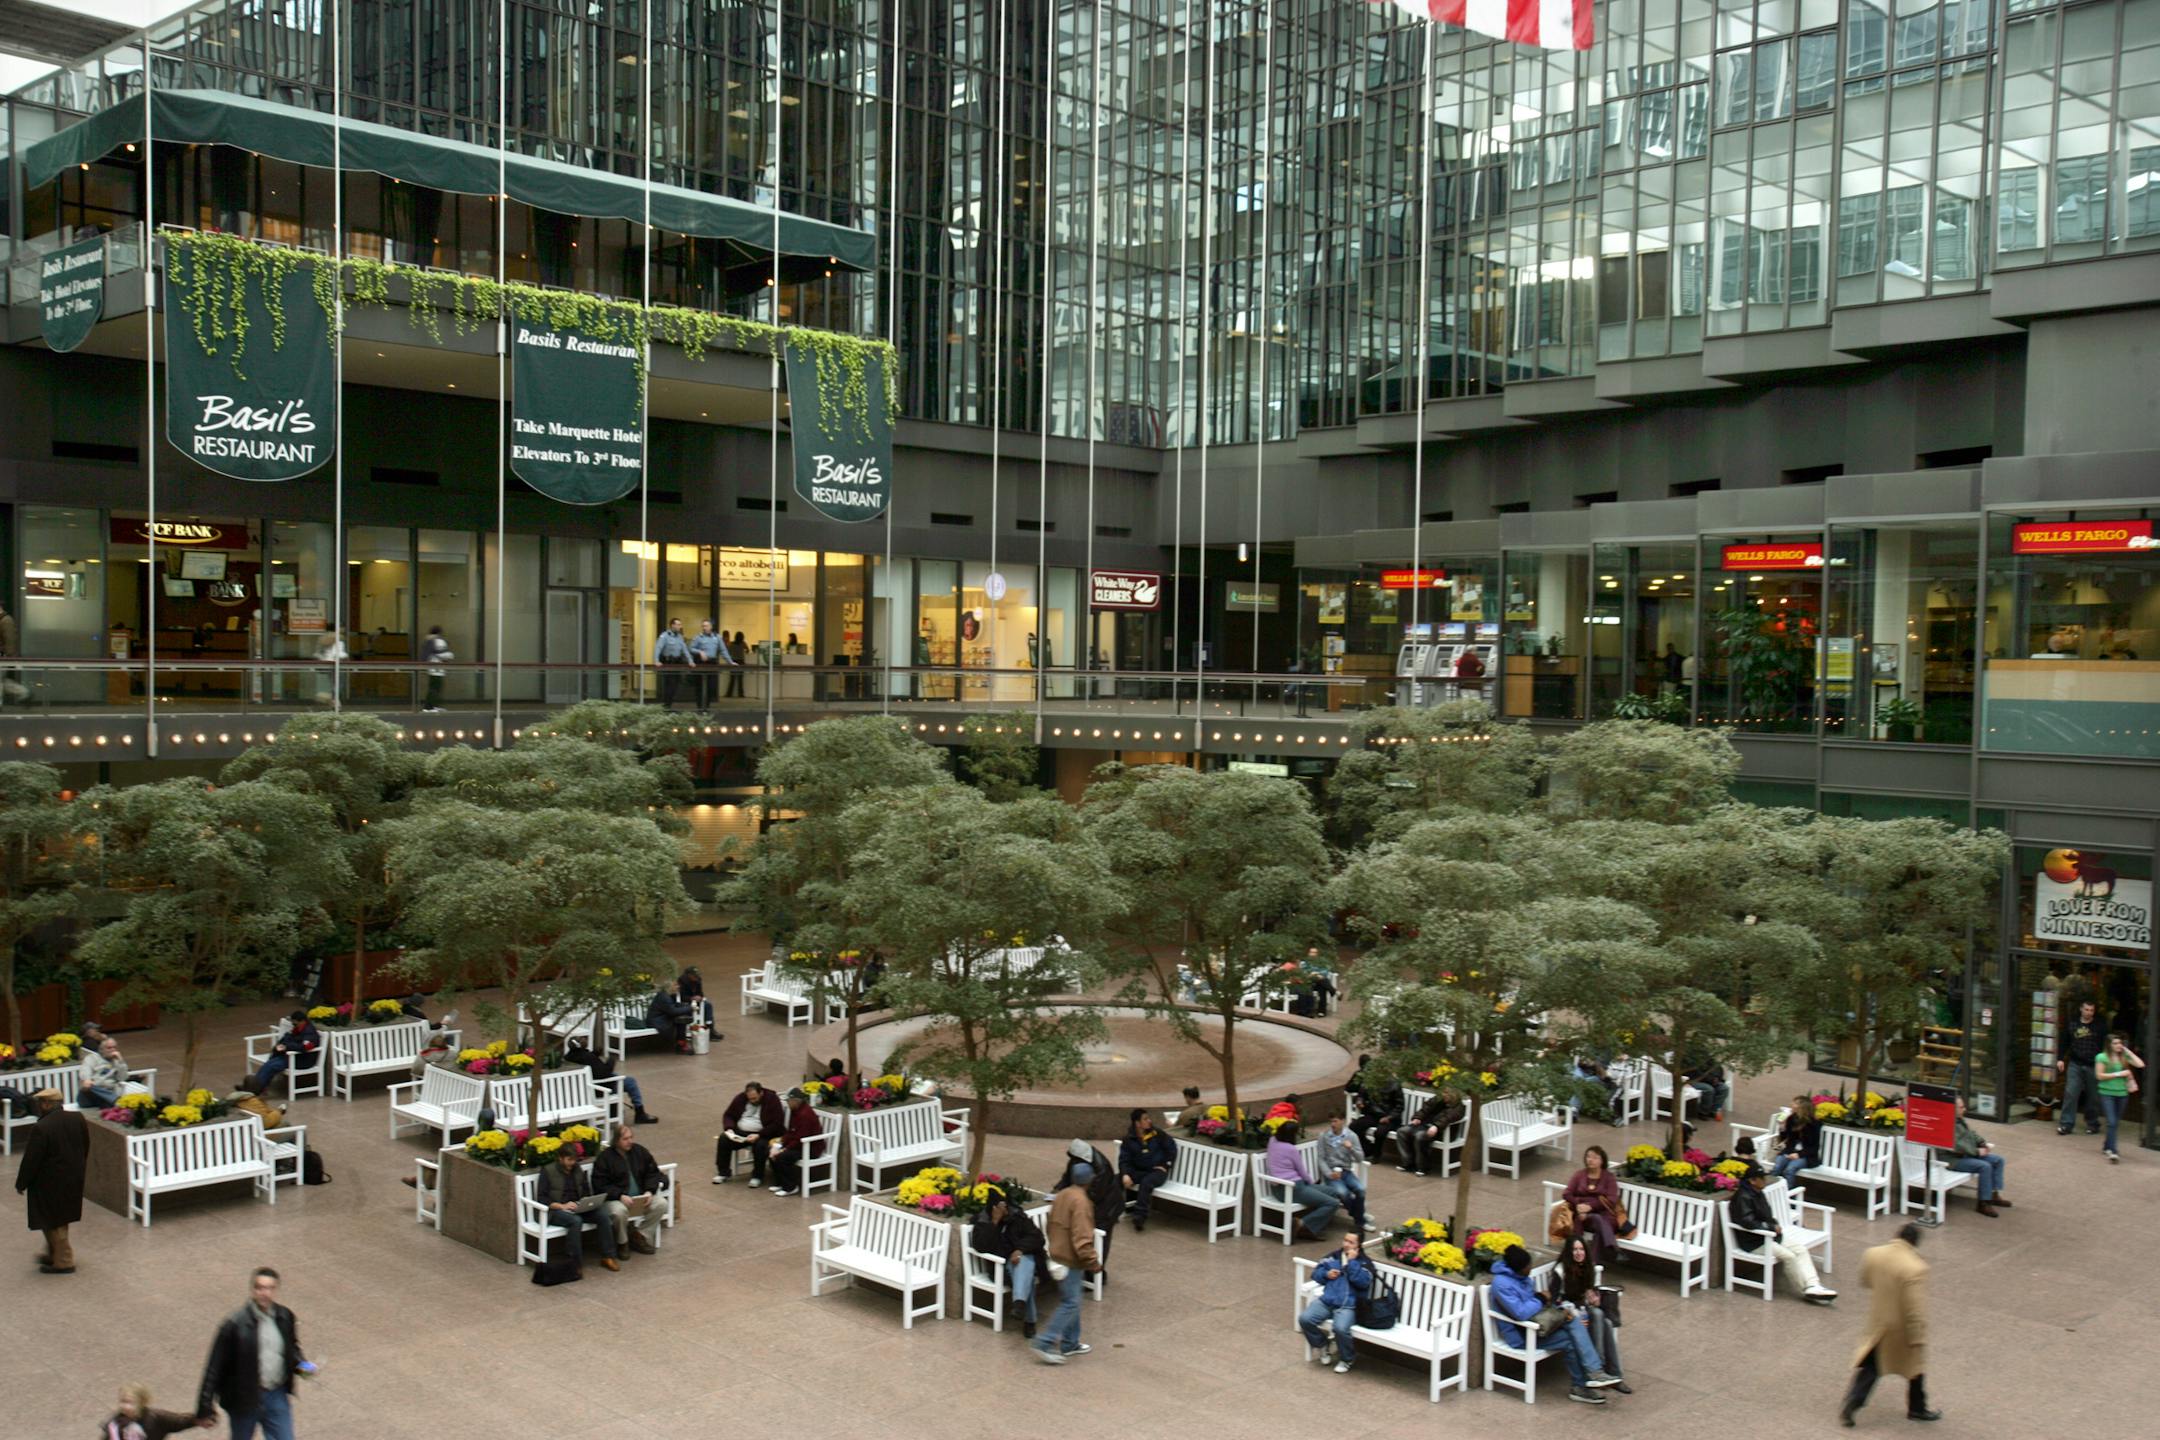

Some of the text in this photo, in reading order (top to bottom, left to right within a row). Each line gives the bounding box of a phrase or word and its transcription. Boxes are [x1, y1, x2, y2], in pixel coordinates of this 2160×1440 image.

[517, 328, 561, 349] Basils
[194, 395, 316, 434] Basil's
[513, 418, 545, 434] Take
[548, 421, 610, 441] Marquette
[193, 435, 316, 463] RESTAURANT
[512, 445, 571, 462] Elevators
[573, 450, 590, 464] To
[812, 454, 882, 484] Basil's
[812, 486, 882, 508] RESTAURANT
[174, 523, 213, 537] BANK
[2019, 529, 2128, 542] WELLS FARGO
[1727, 550, 1806, 561] WELLS FARGO
[1094, 576, 1137, 591] White Way
[1095, 589, 1132, 602] CLEANERS
[2048, 899, 2146, 925] LOVE FROM
[2040, 917, 2152, 944] MINNESOTA
